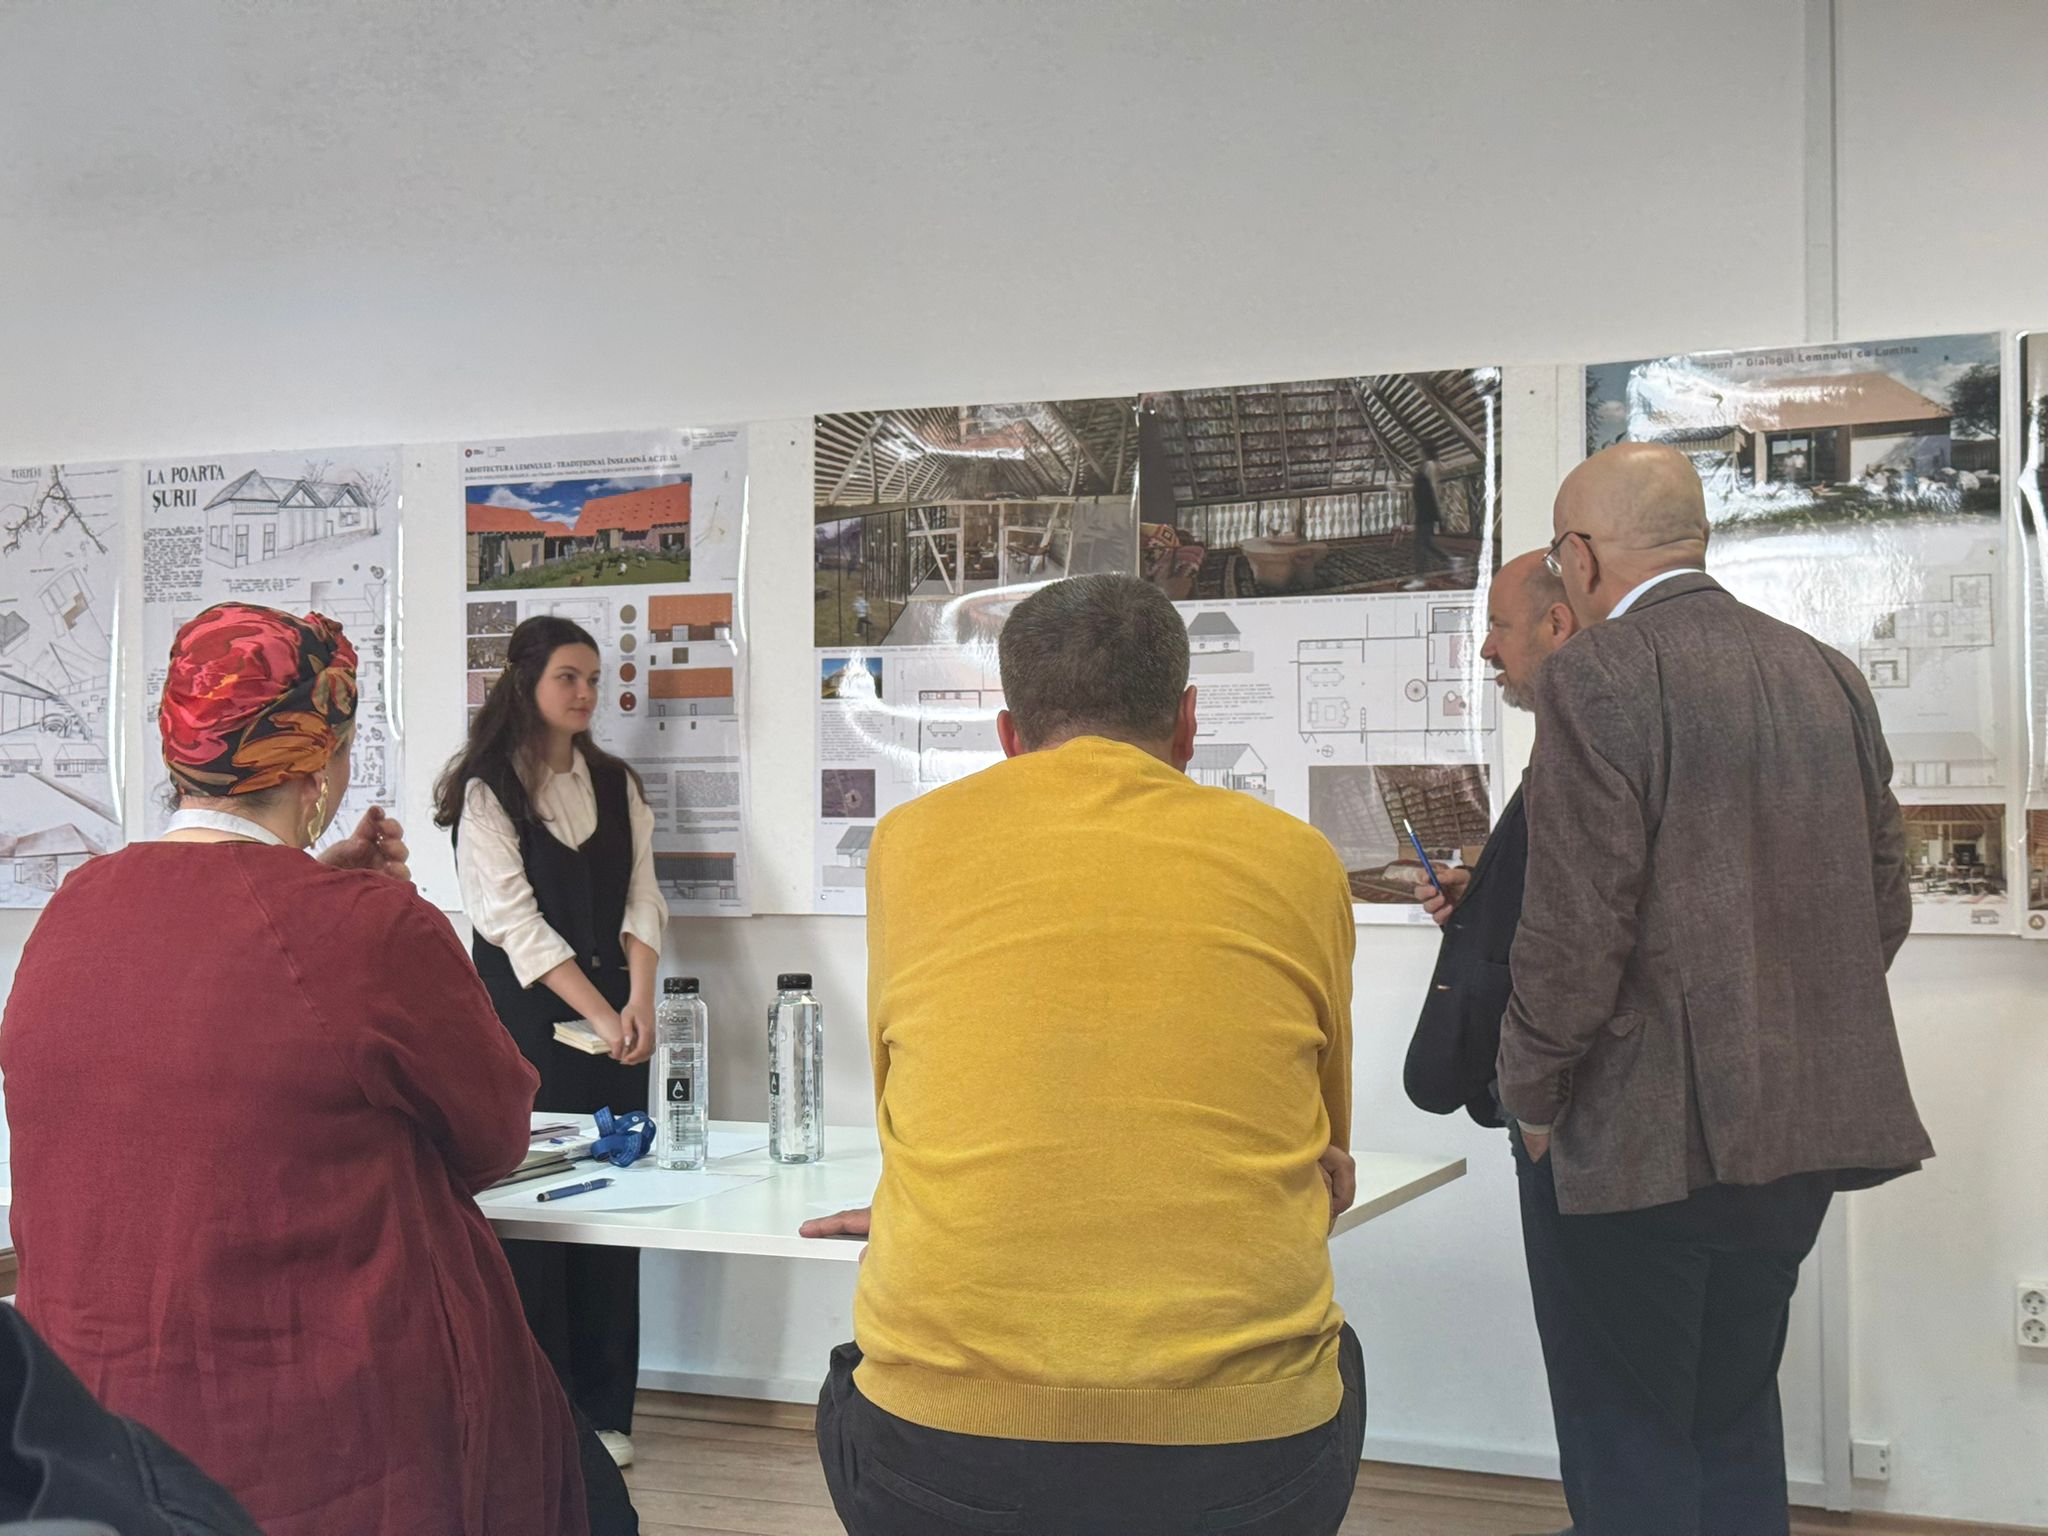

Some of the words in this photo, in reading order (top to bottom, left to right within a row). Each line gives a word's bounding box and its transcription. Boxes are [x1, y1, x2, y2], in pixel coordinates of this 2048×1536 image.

[1746, 354, 1795, 367] Dialogul
[1798, 349, 1852, 362] Lemnului
[1875, 346, 1919, 357] Lumina
[147, 469, 166, 486] LA
[171, 464, 226, 484] POARTA
[465, 463, 514, 473] ARHITECTURA
[152, 488, 197, 513] ȘURII
